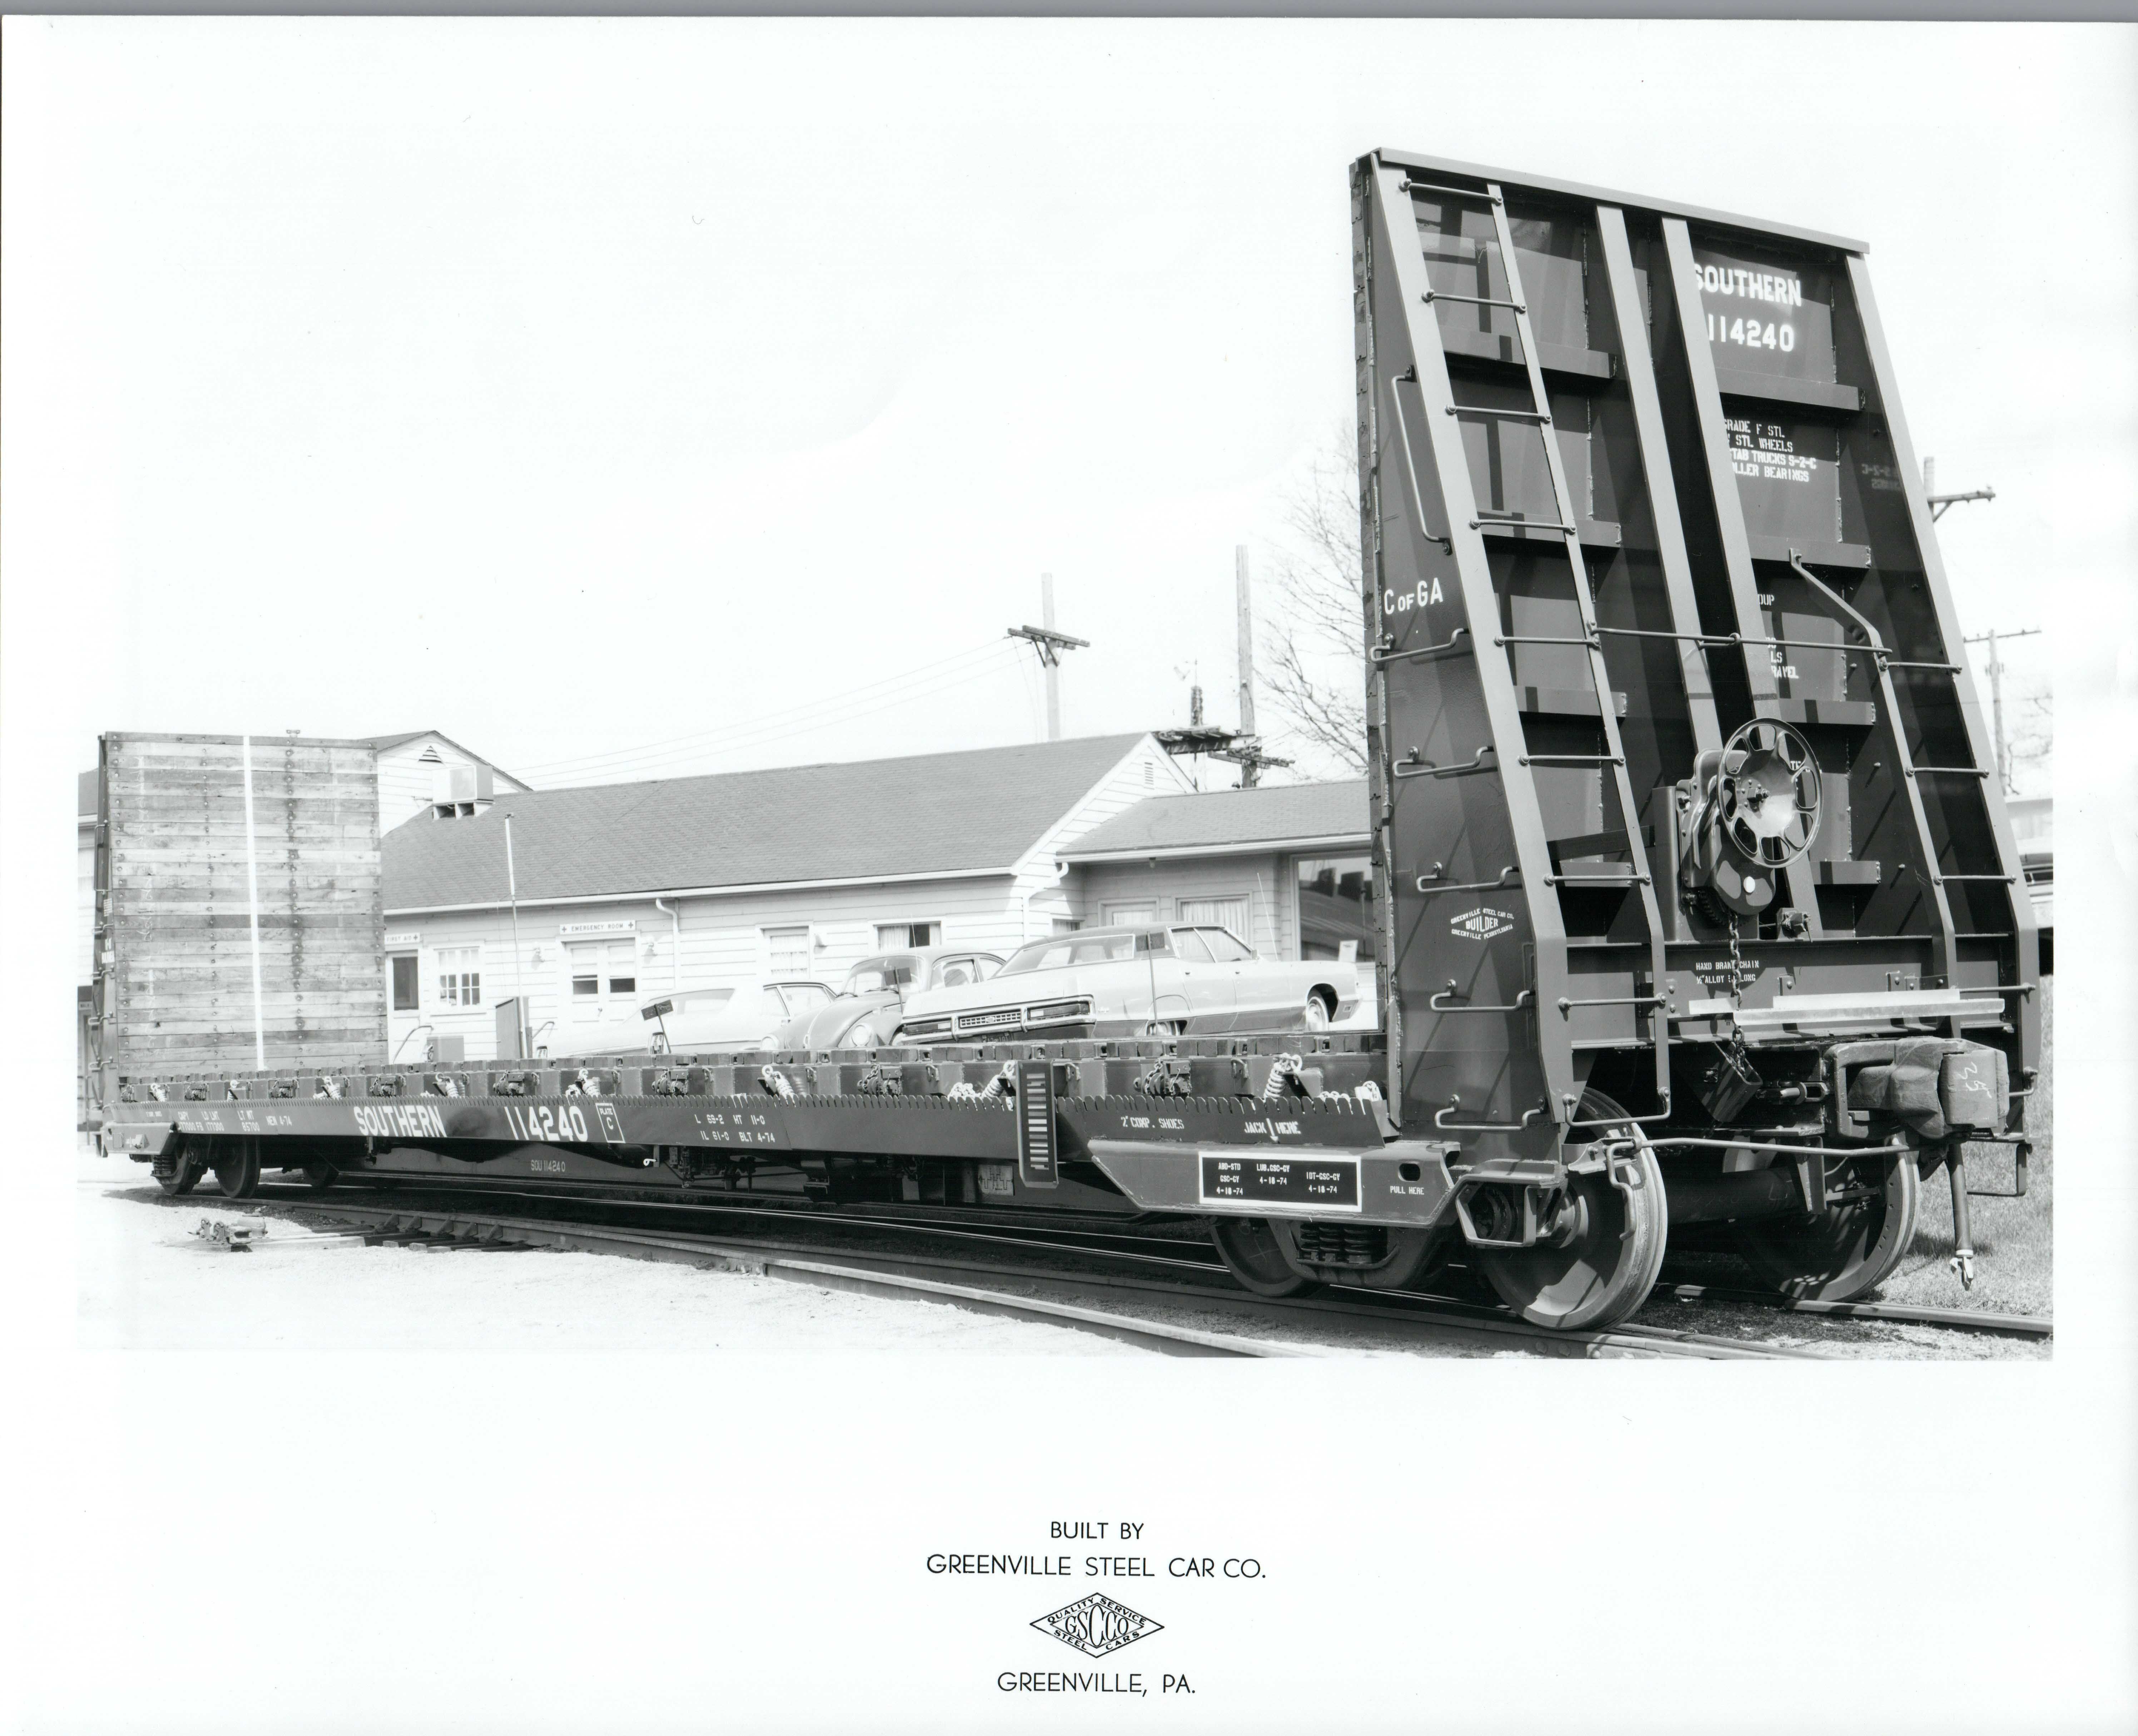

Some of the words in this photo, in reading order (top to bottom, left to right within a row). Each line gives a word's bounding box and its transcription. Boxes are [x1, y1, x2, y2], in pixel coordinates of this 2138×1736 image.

[1694, 263, 1802, 306] SOUTHERN
[1708, 313, 1795, 352] 114240
[1756, 423, 1762, 435] F
[1768, 425, 1785, 438] STL
[1736, 435, 1754, 447] STL
[1759, 437, 1793, 453] WHEELS
[1730, 448, 1749, 461] TAB
[1751, 450, 1786, 465] TRUCKS
[1788, 455, 1817, 469] S-2-C
[1764, 466, 1810, 483] BEARINGS
[1384, 589, 1395, 615] C
[1417, 577, 1443, 607] GA
[1450, 908, 1481, 924] GREENVILLE
[1483, 908, 1496, 916] STEEL
[1466, 916, 1498, 932] BUILDER
[1451, 929, 1481, 940] GREENVILLE
[1484, 924, 1513, 940] PENNSYLVANIA
[1696, 962, 1712, 971] HAND
[1716, 961, 1733, 970] BRAK
[1739, 960, 1759, 969] CHAIN
[1705, 975, 1724, 984] ALLOY
[279, 1115, 292, 1126] 4-74
[353, 1105, 447, 1138] SOUTHERN
[504, 1106, 588, 1142] 114240
[606, 1117, 614, 1130] C
[694, 1114, 702, 1124] L
[733, 1114, 743, 1124] HT
[751, 1115, 766, 1125] 11-0
[1158, 1118, 1185, 1129] SHOES
[1244, 1121, 1267, 1134] JACK
[1275, 1121, 1301, 1134] HERE
[738, 1132, 752, 1142] BLT
[757, 1132, 775, 1143] 4-74
[531, 1159, 543, 1172] SOU
[544, 1160, 566, 1172] 114240
[1218, 1162, 1241, 1171] ABD-STD
[1390, 1186, 1406, 1195] PULL
[1409, 1187, 1425, 1195] HERE
